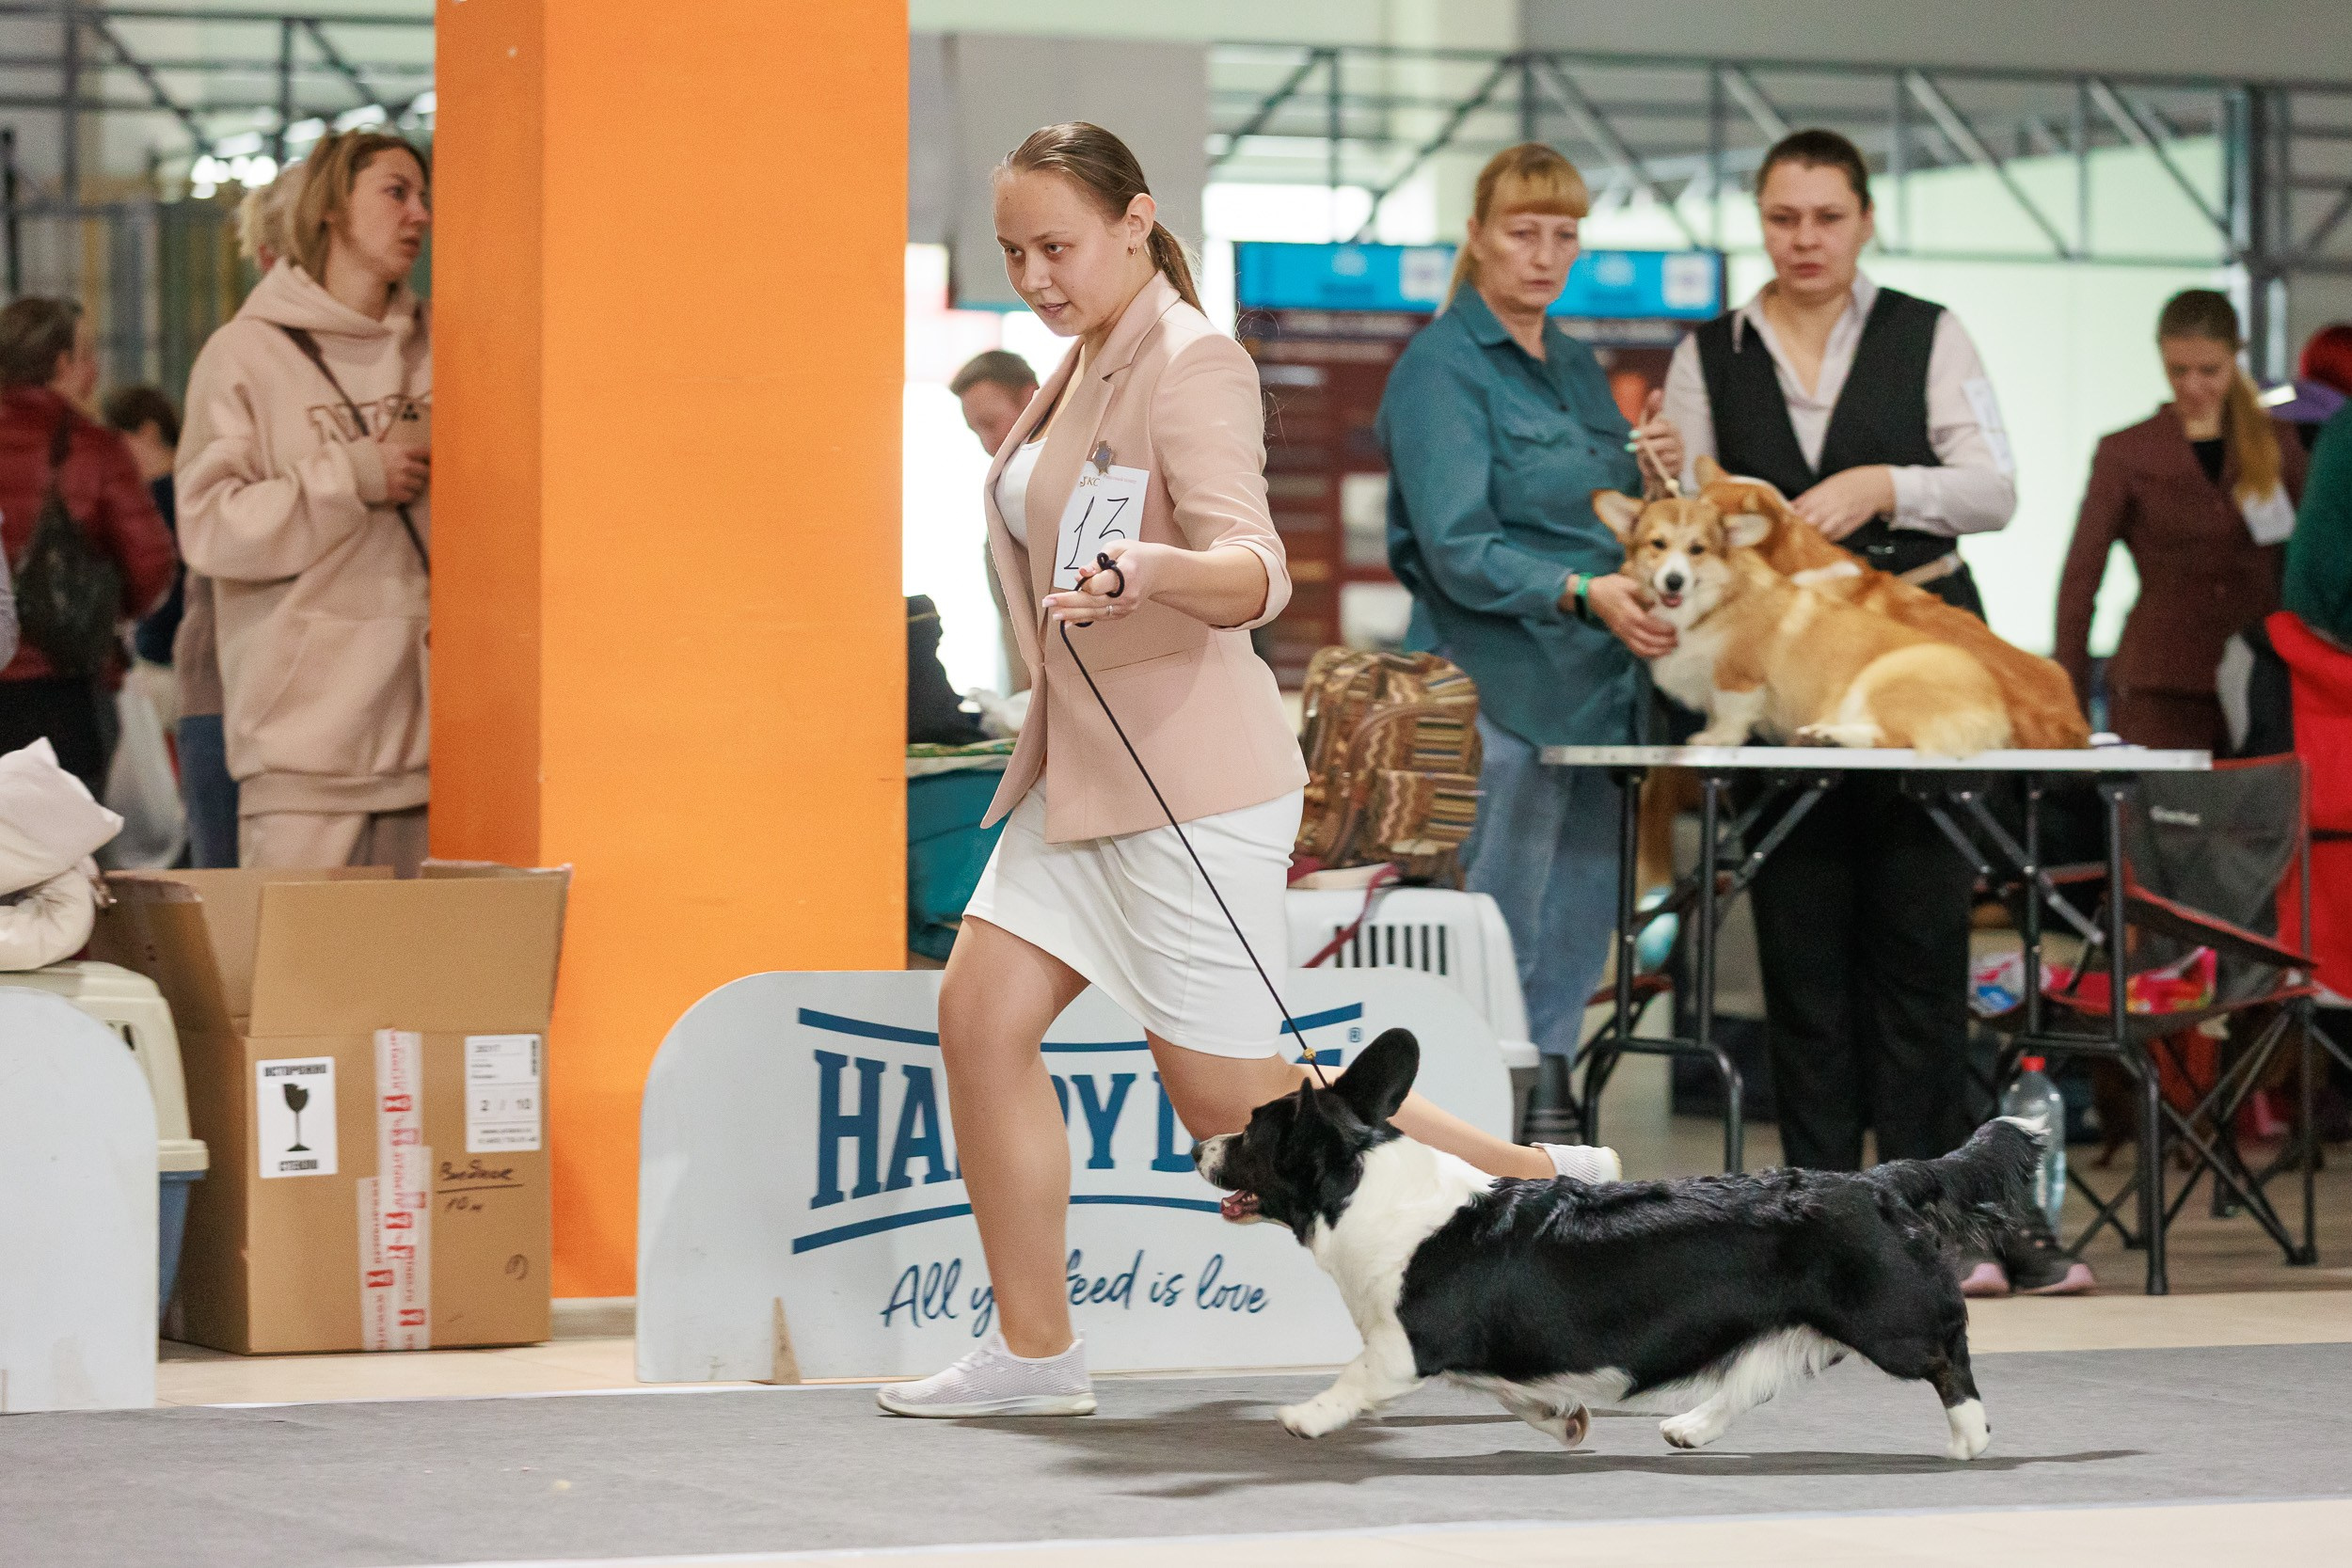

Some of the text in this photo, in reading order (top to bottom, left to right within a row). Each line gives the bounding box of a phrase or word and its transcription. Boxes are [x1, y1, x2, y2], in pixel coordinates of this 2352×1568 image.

[1063, 496, 1130, 570] 13
[809, 1048, 1137, 1211] HAY
[879, 1257, 962, 1328] All
[1150, 1272, 1185, 1307] is
[1196, 1253, 1270, 1314] love
